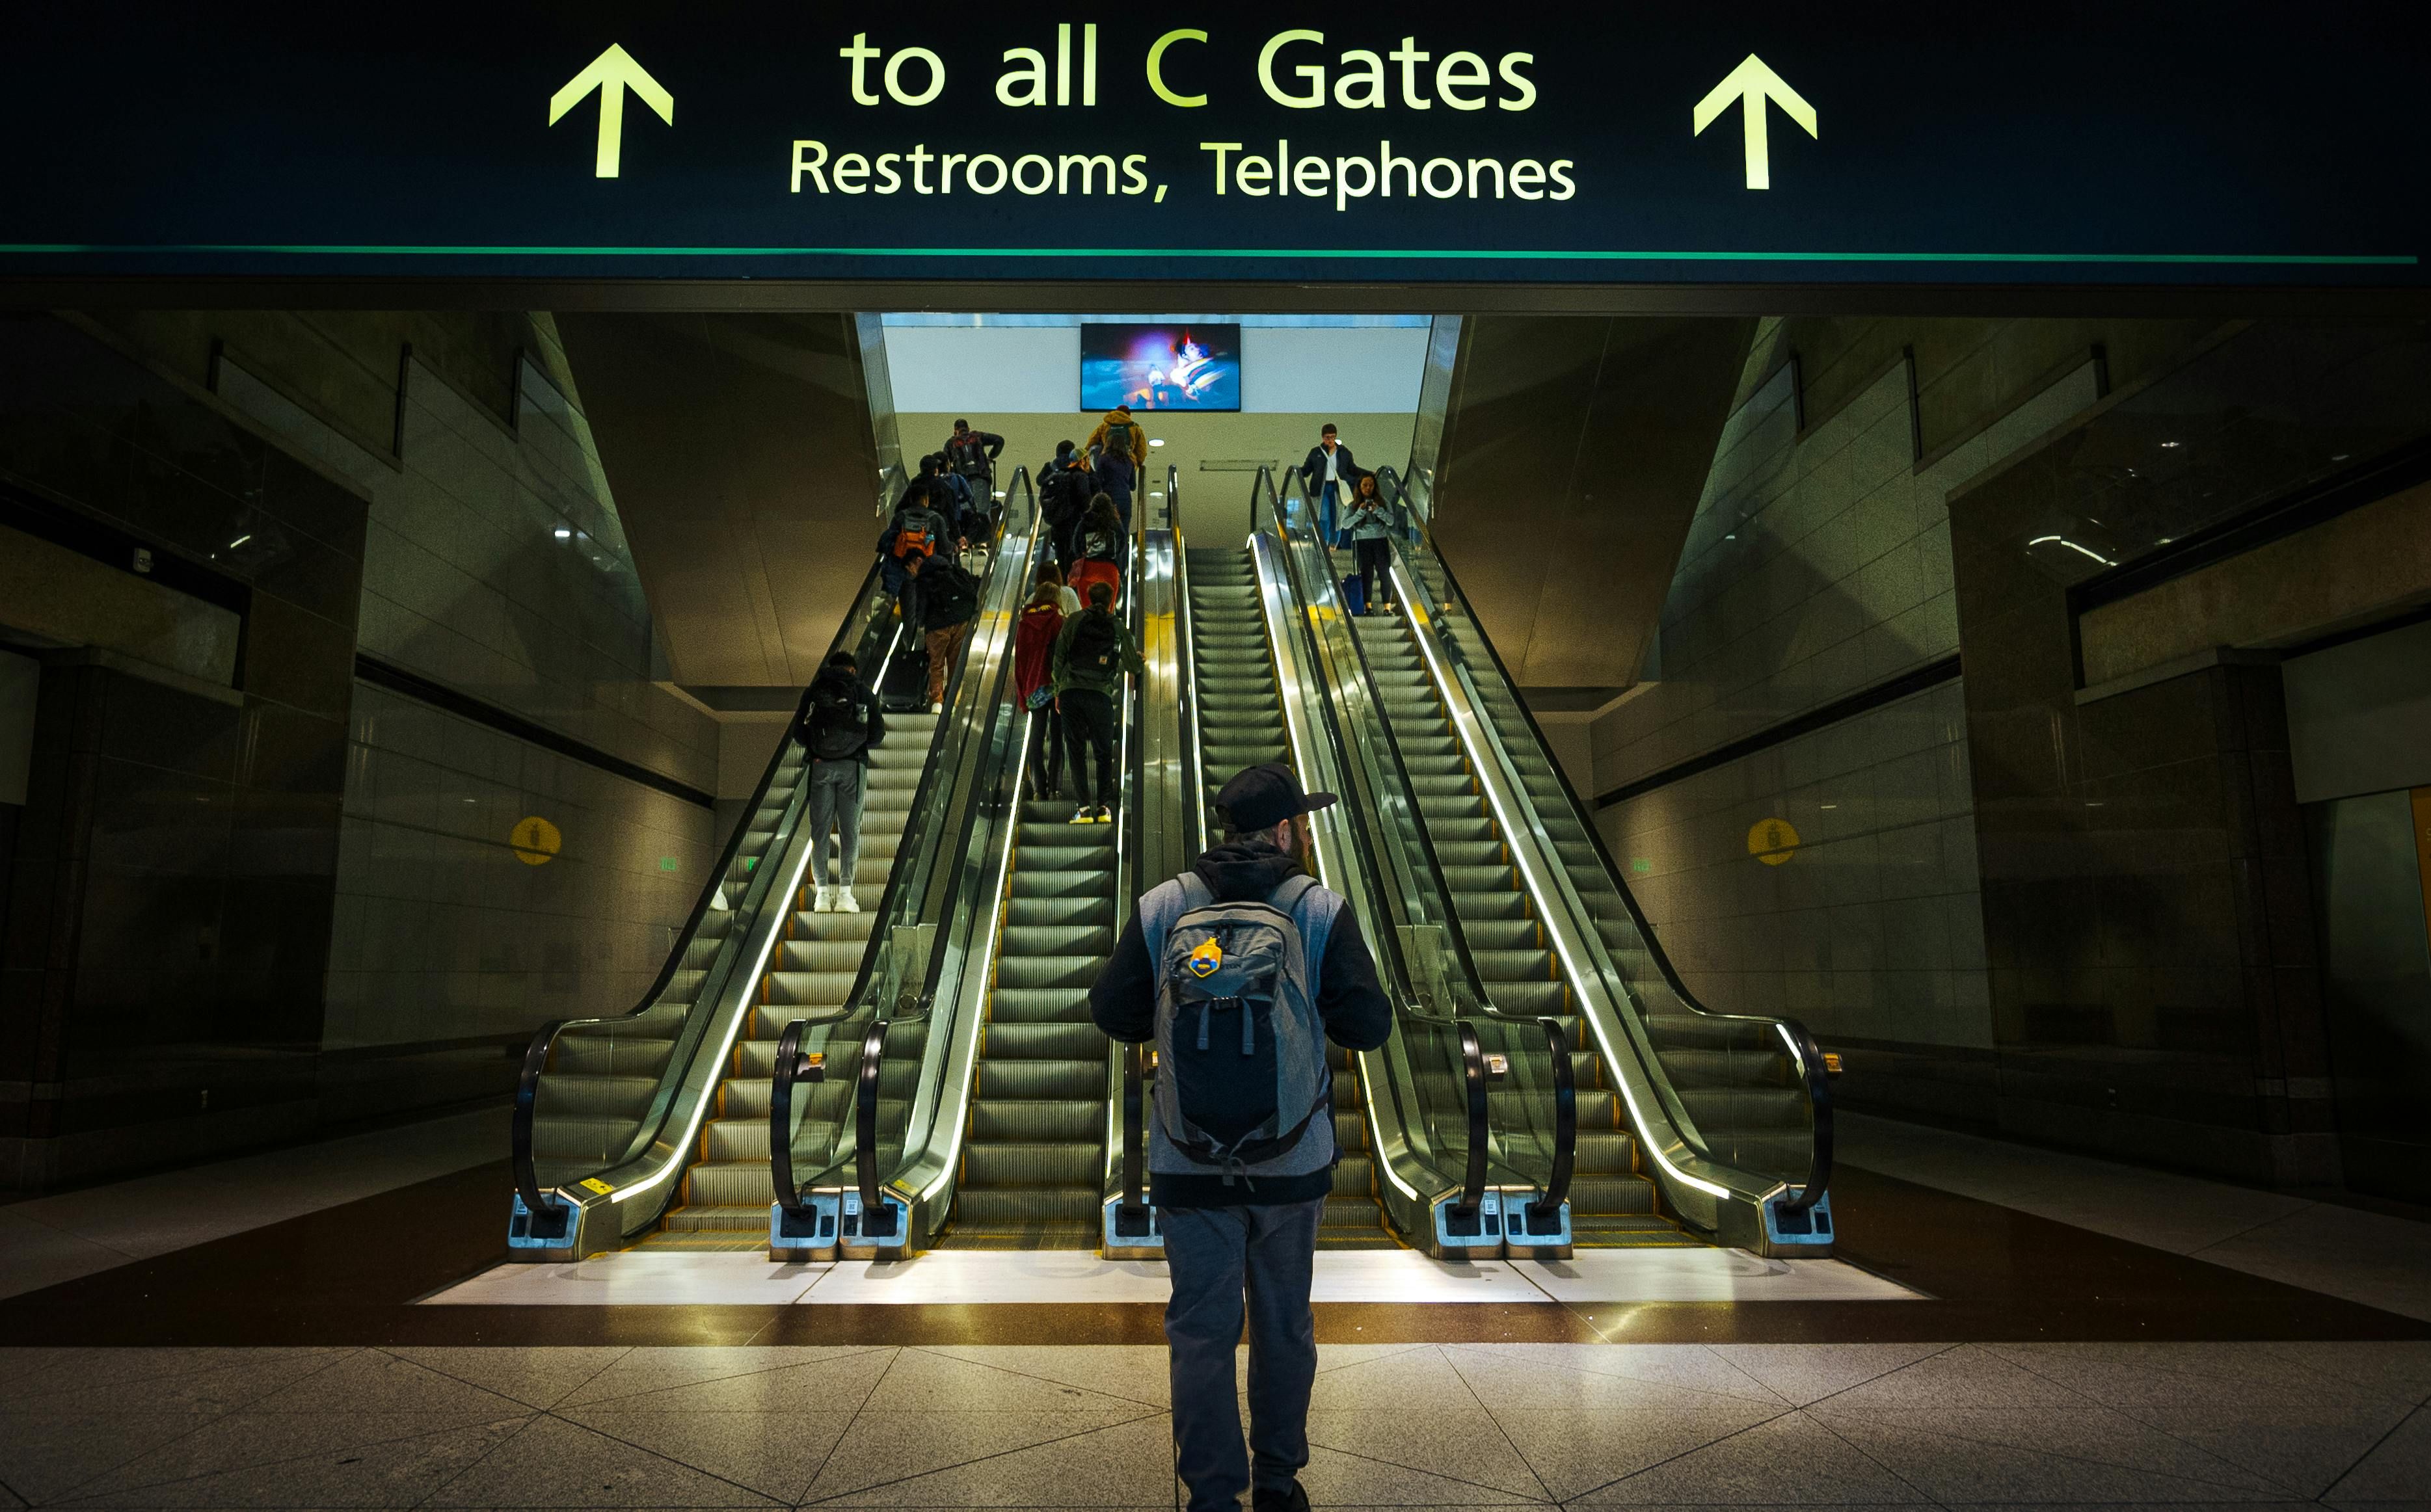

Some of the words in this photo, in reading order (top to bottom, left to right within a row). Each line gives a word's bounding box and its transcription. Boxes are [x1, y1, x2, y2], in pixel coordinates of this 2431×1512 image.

[839, 32, 945, 106] to
[995, 23, 1097, 107] all
[1146, 29, 1208, 107] C
[1257, 29, 1537, 111] Gates
[790, 140, 1168, 203] Restrooms,
[1200, 139, 1576, 211] Telephones
